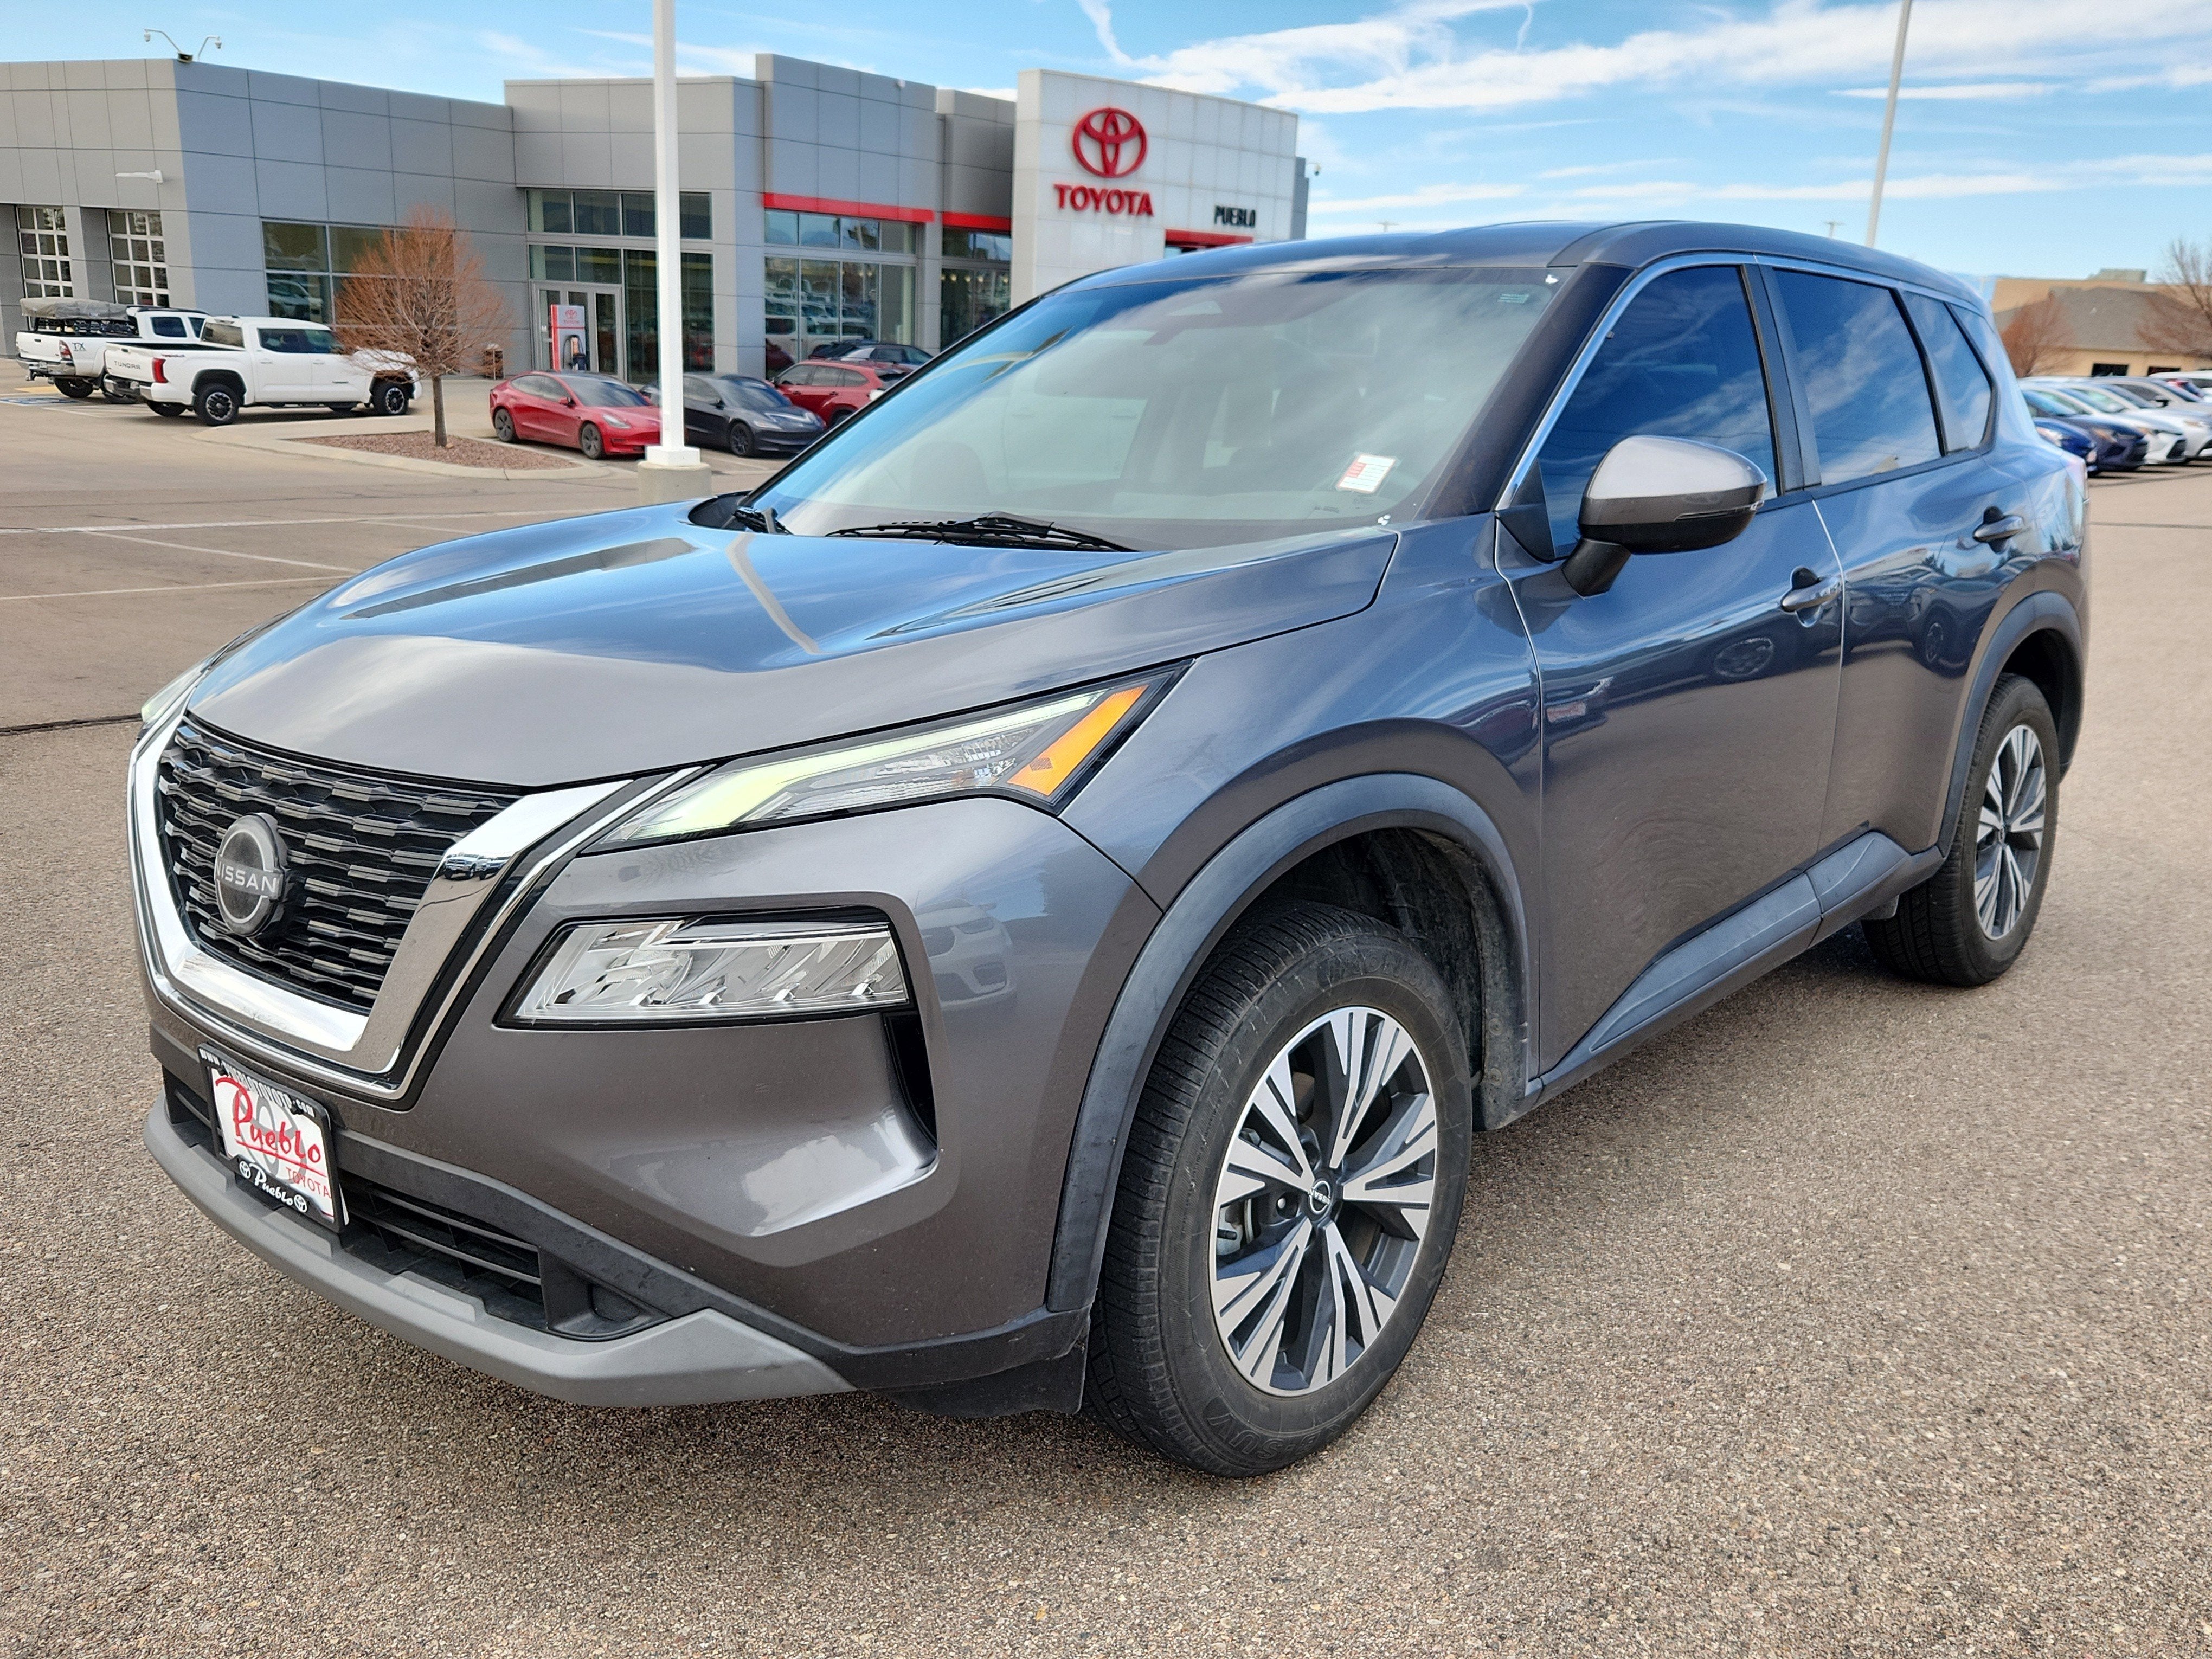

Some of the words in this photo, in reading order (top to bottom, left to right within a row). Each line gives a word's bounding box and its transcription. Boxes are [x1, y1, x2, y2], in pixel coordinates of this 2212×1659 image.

[1053, 183, 1154, 217] TOYOTA
[1214, 205, 1256, 228] PUEBLO
[114, 360, 141, 370] TUNDRA
[216, 861, 277, 893] NISSAN
[215, 1077, 321, 1163] Pueblo
[249, 1163, 293, 1206] Pueblo
[285, 1167, 332, 1199] TOYOTA
